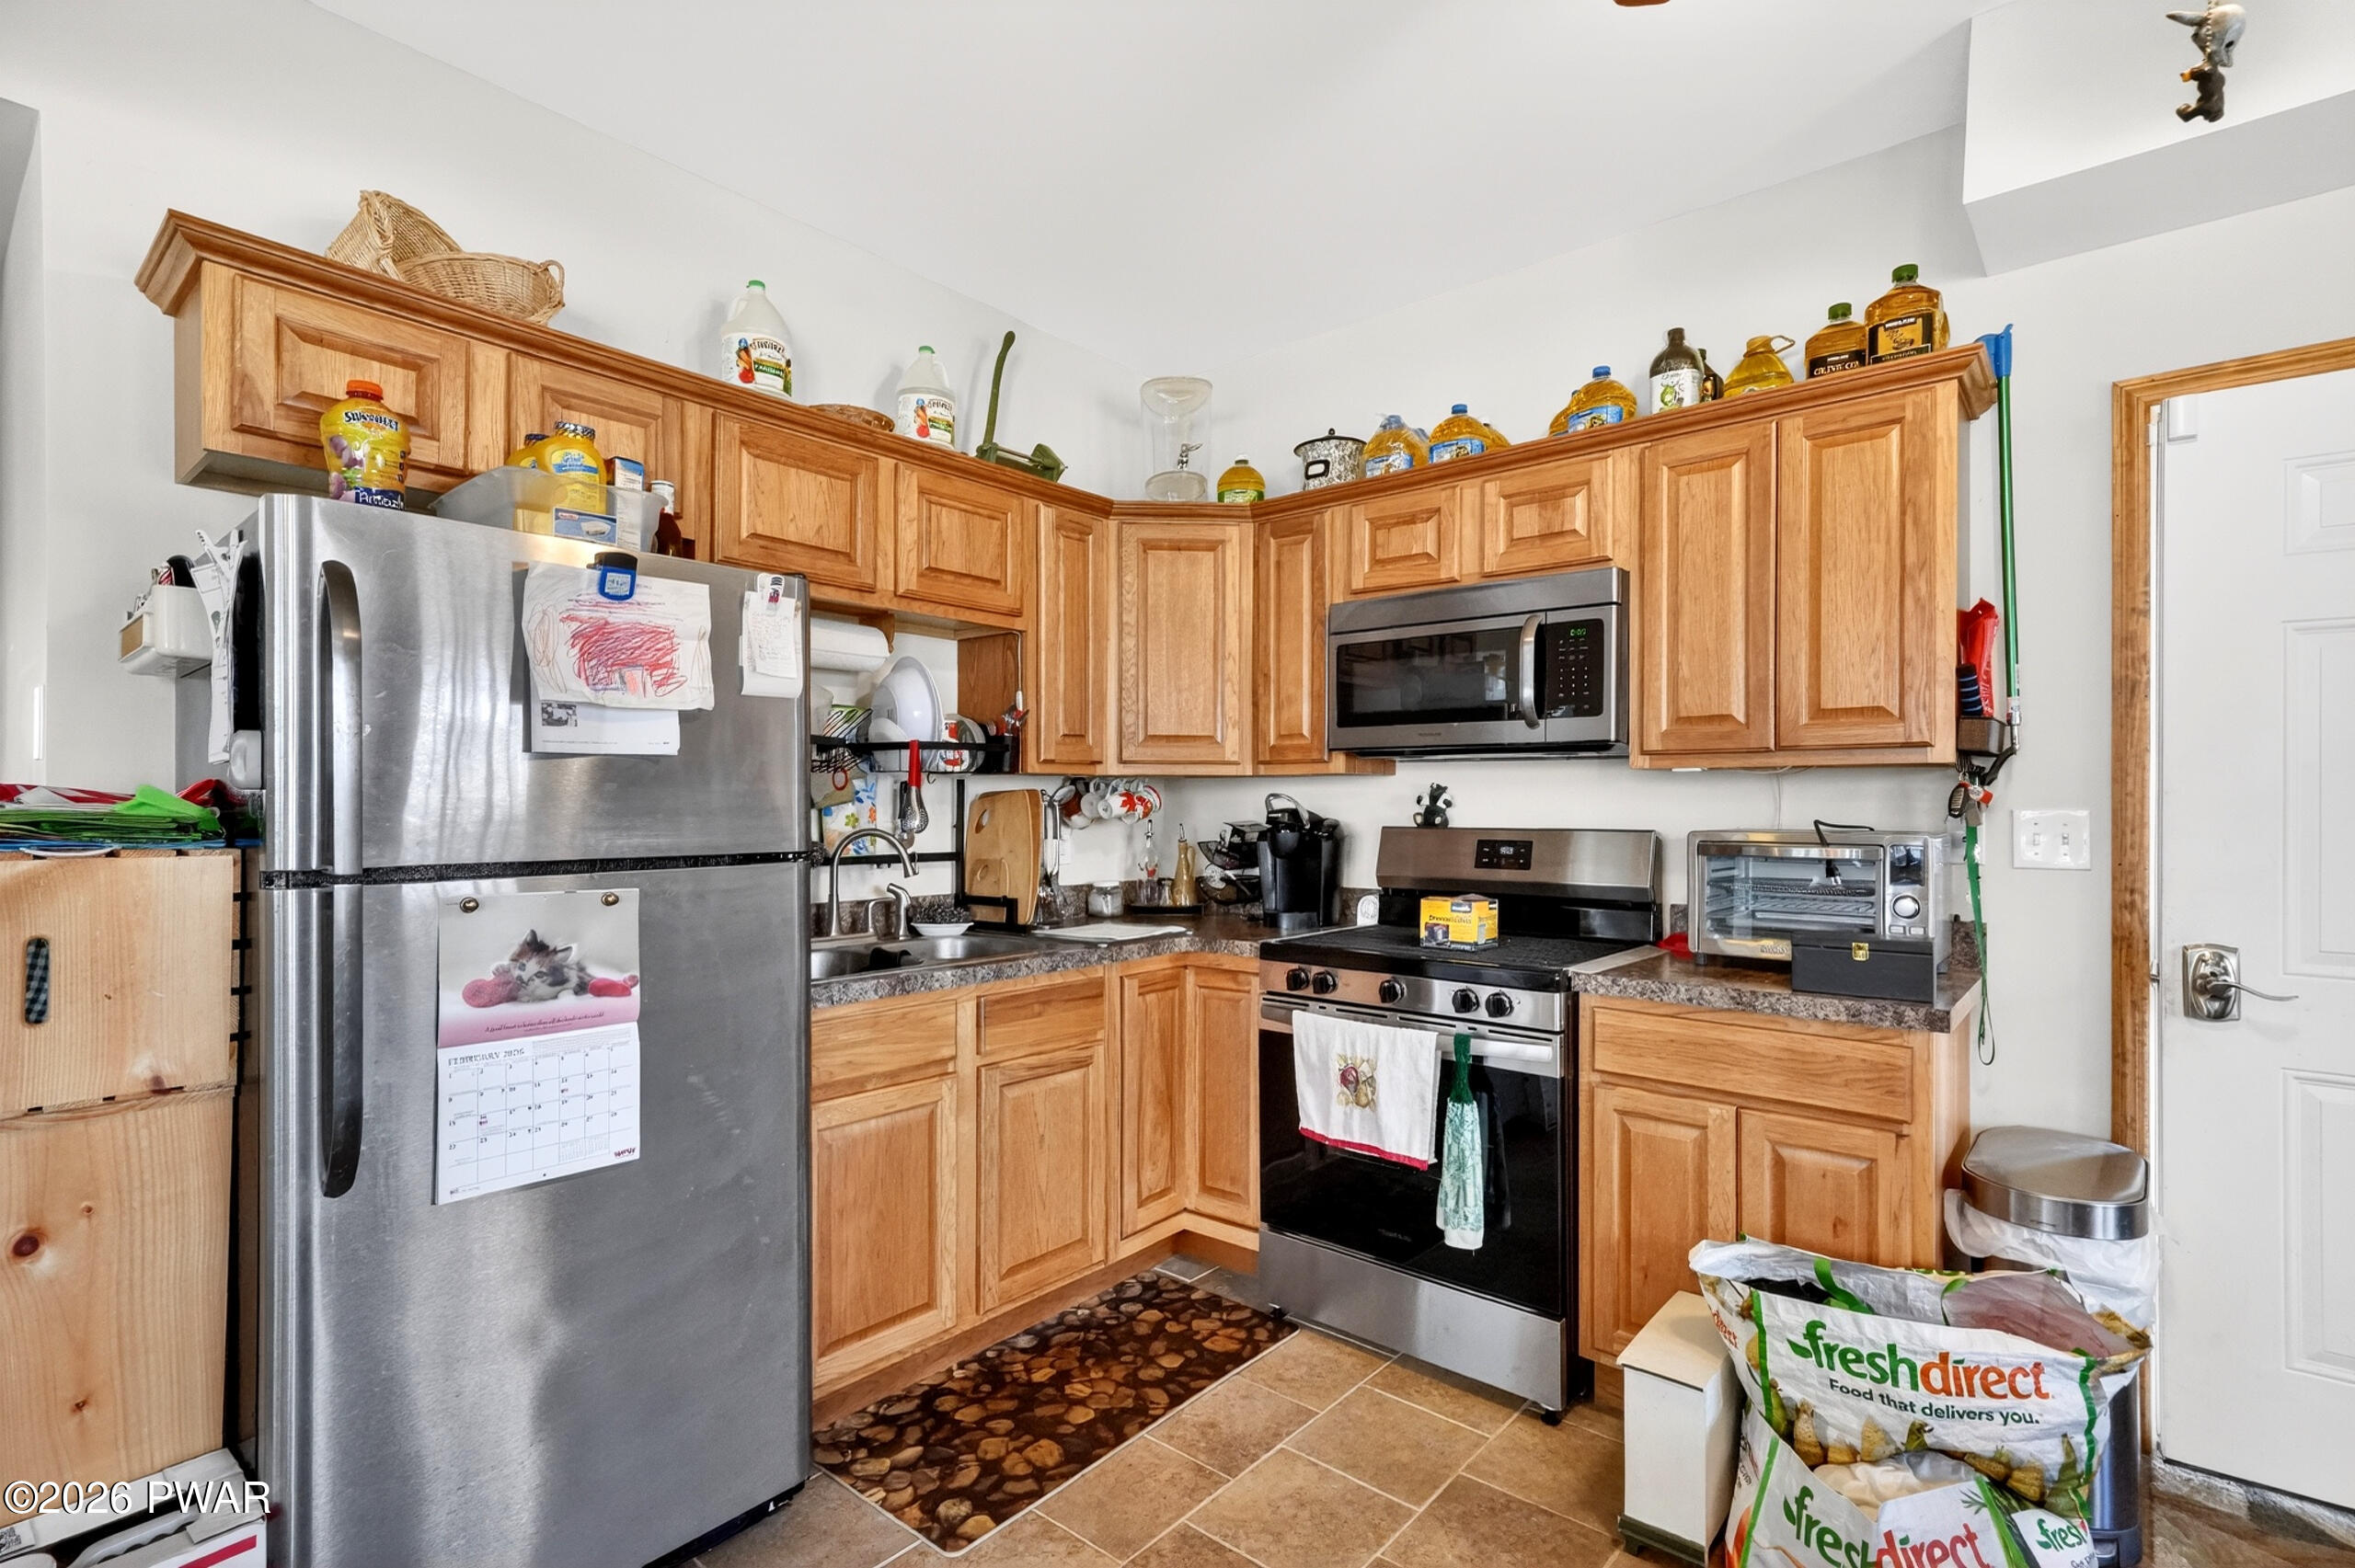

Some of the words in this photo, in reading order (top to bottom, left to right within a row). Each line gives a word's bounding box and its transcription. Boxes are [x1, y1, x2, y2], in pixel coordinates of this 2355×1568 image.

[1787, 1320, 2051, 1400] freshdirect
[1829, 1378, 1874, 1401] Food
[1878, 1392, 1916, 1413] that
[1921, 1402, 1994, 1422] delivers
[1999, 1410, 2039, 1426] you.
